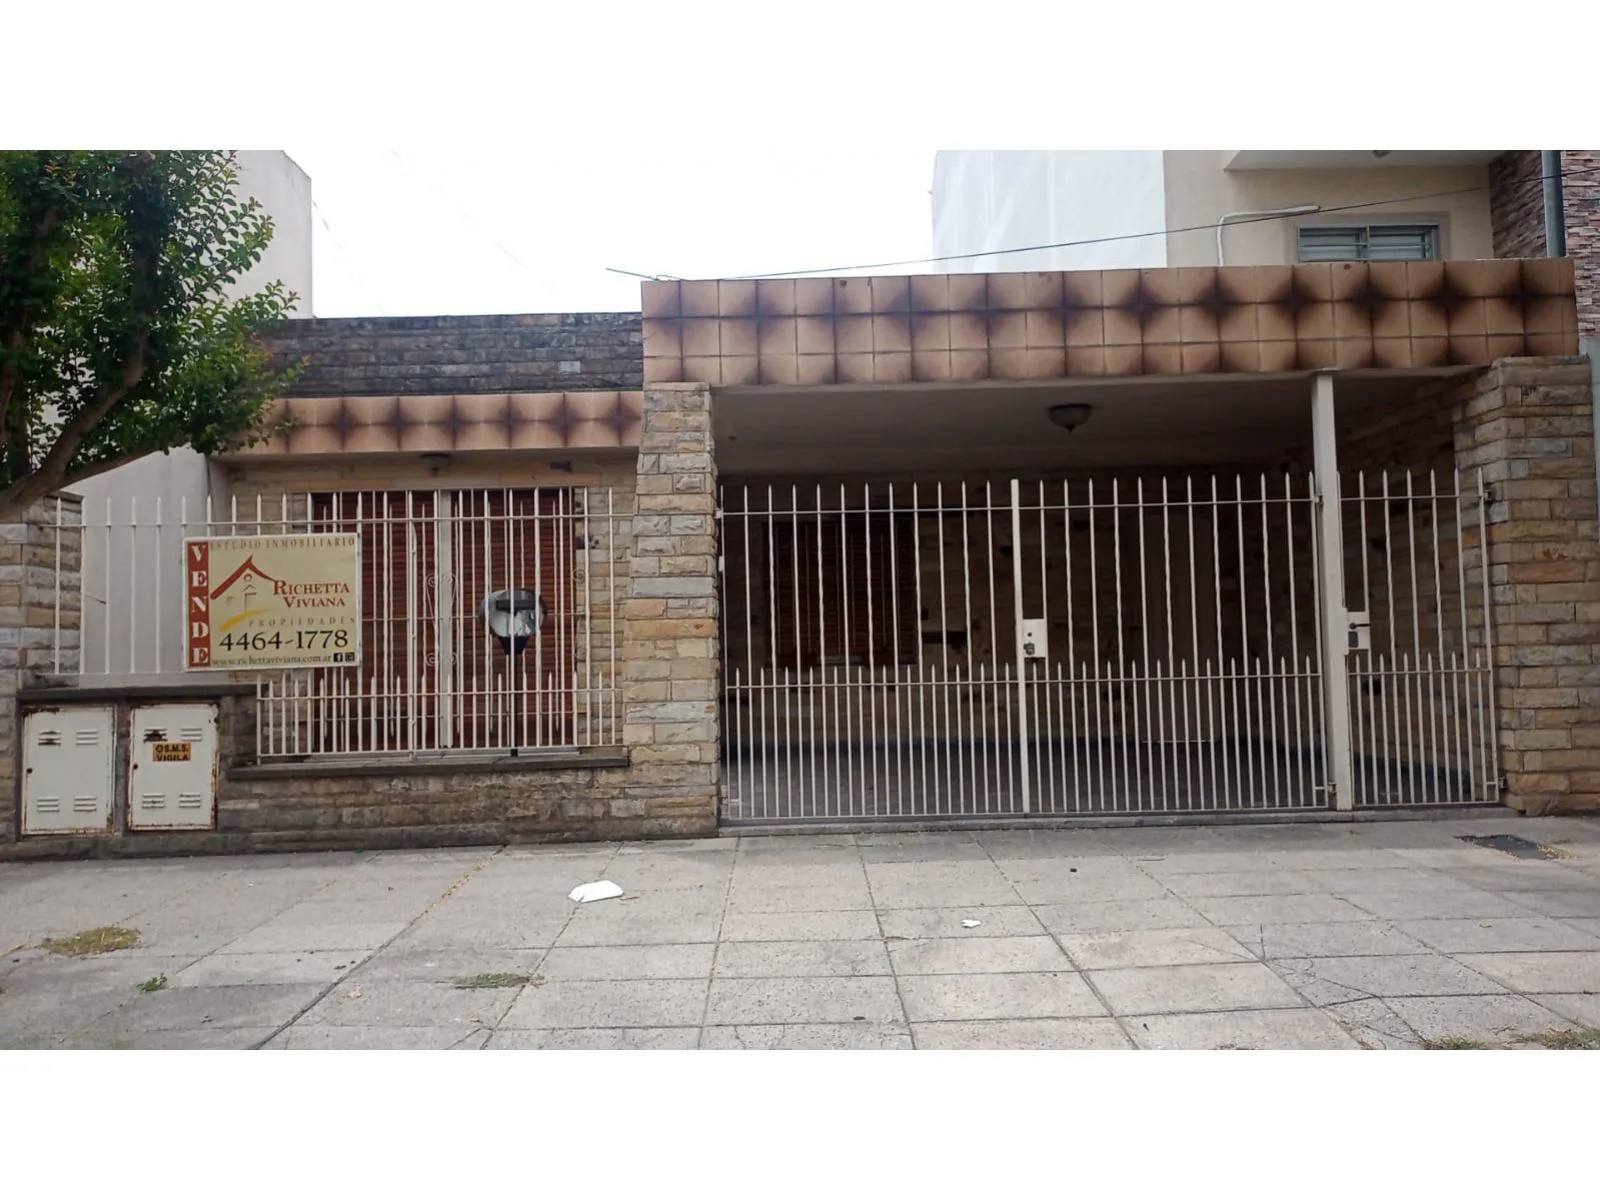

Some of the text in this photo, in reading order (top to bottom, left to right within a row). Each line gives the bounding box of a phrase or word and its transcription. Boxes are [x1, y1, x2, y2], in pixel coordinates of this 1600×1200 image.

[266, 537, 355, 549] INMOBILIARIO
[273, 580, 350, 596] RICHETTA
[191, 545, 209, 664] VENDE
[283, 596, 346, 608] VIVIANA
[248, 617, 356, 628] PROPIEDADES
[219, 629, 348, 651] 4464-1778
[212, 653, 331, 666] www.richettaviviana.com.ar
